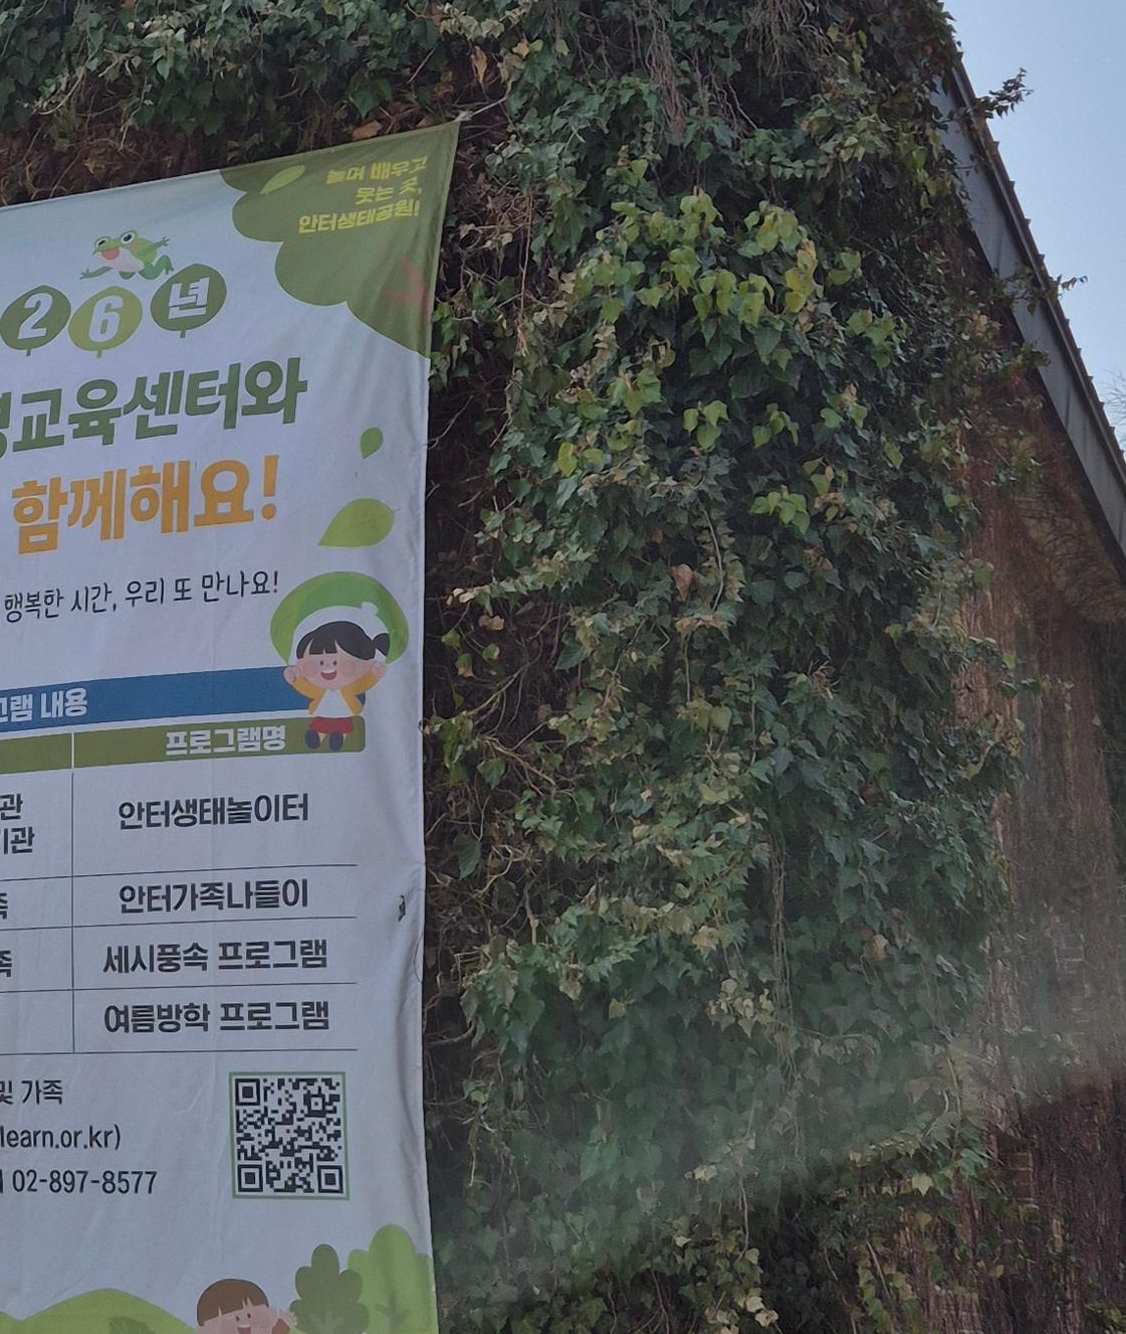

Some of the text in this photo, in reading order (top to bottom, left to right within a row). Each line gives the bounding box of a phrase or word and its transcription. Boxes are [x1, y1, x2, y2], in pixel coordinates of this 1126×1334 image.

[370, 155, 427, 180] 배우고
[298, 199, 420, 234] 안터생태공원!
[12, 454, 280, 555] 함께해요!
[4, 588, 64, 623] 행복한
[70, 582, 117, 613] 시간,
[124, 577, 164, 607] 우리
[173, 577, 192, 602] 또
[202, 570, 278, 603] 만나요!
[40, 687, 88, 719] 내용
[166, 725, 286, 756] 프로그램명
[118, 793, 309, 830] 안터생태놀이터
[119, 878, 308, 914] 안터가족나들이
[103, 939, 328, 974] 세시풍속 프로그램
[104, 1001, 330, 1033] 여름방학 프로그램
[21, 1079, 64, 1106] 가족
[12, 1169, 158, 1195] 02-897-8577
